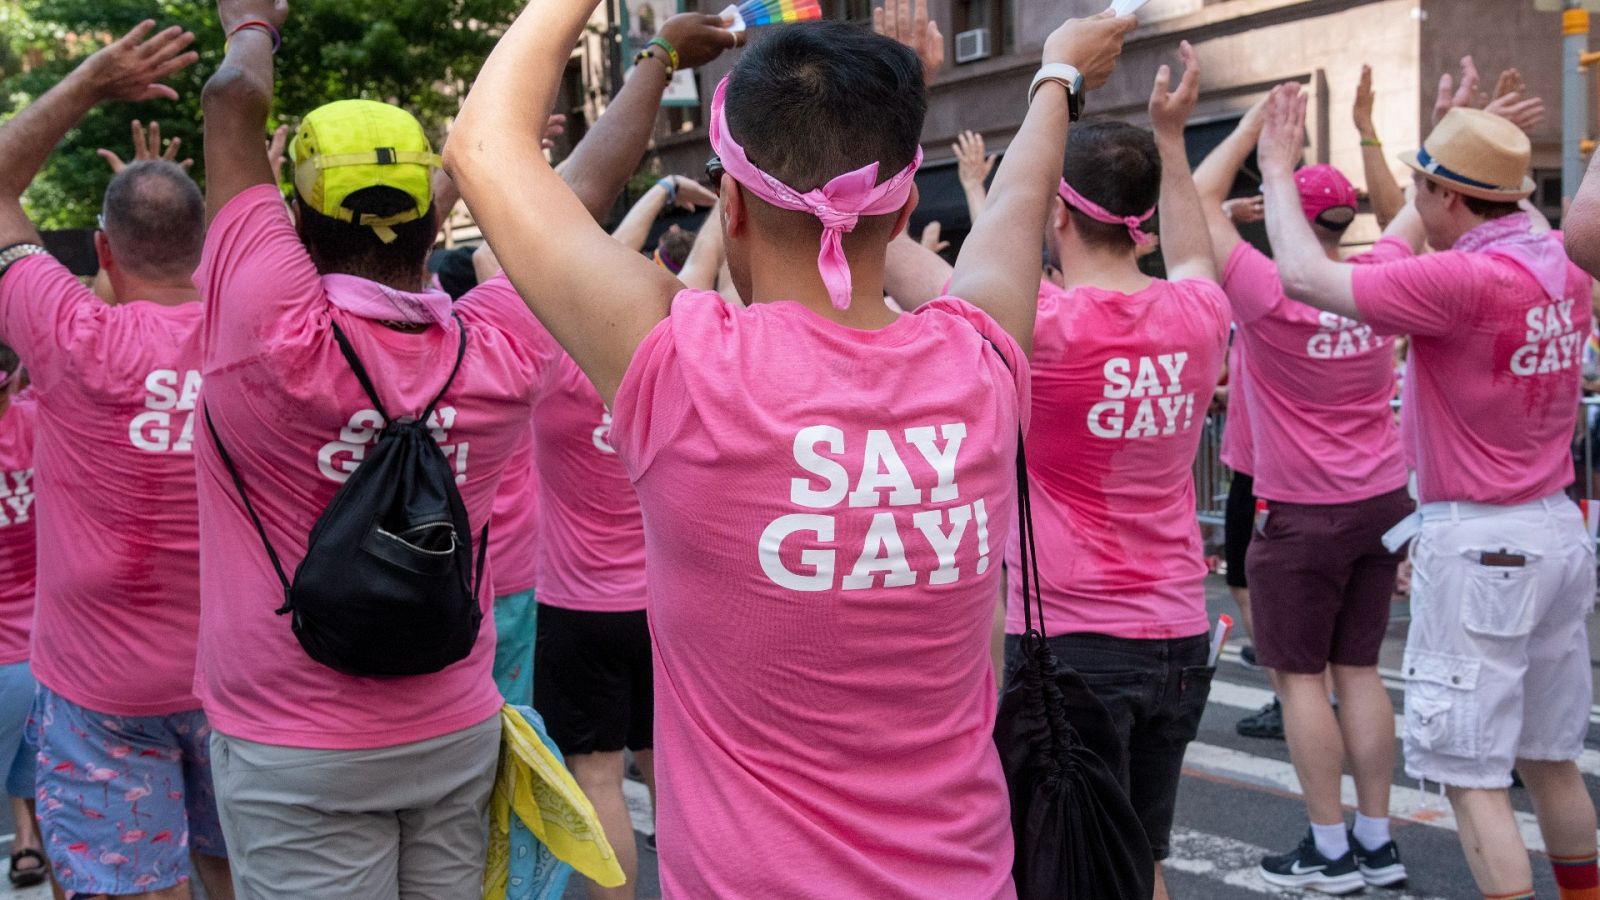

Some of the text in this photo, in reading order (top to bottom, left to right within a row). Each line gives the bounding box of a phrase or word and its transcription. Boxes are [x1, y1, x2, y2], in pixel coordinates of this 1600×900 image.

[1526, 298, 1575, 342] SAY
[1103, 351, 1188, 399] SAY
[1509, 330, 1581, 376] GAY!
[339, 406, 458, 444] SY
[1087, 392, 1194, 439] GAY!
[790, 422, 967, 508] SAY
[758, 498, 990, 592] GAY!
